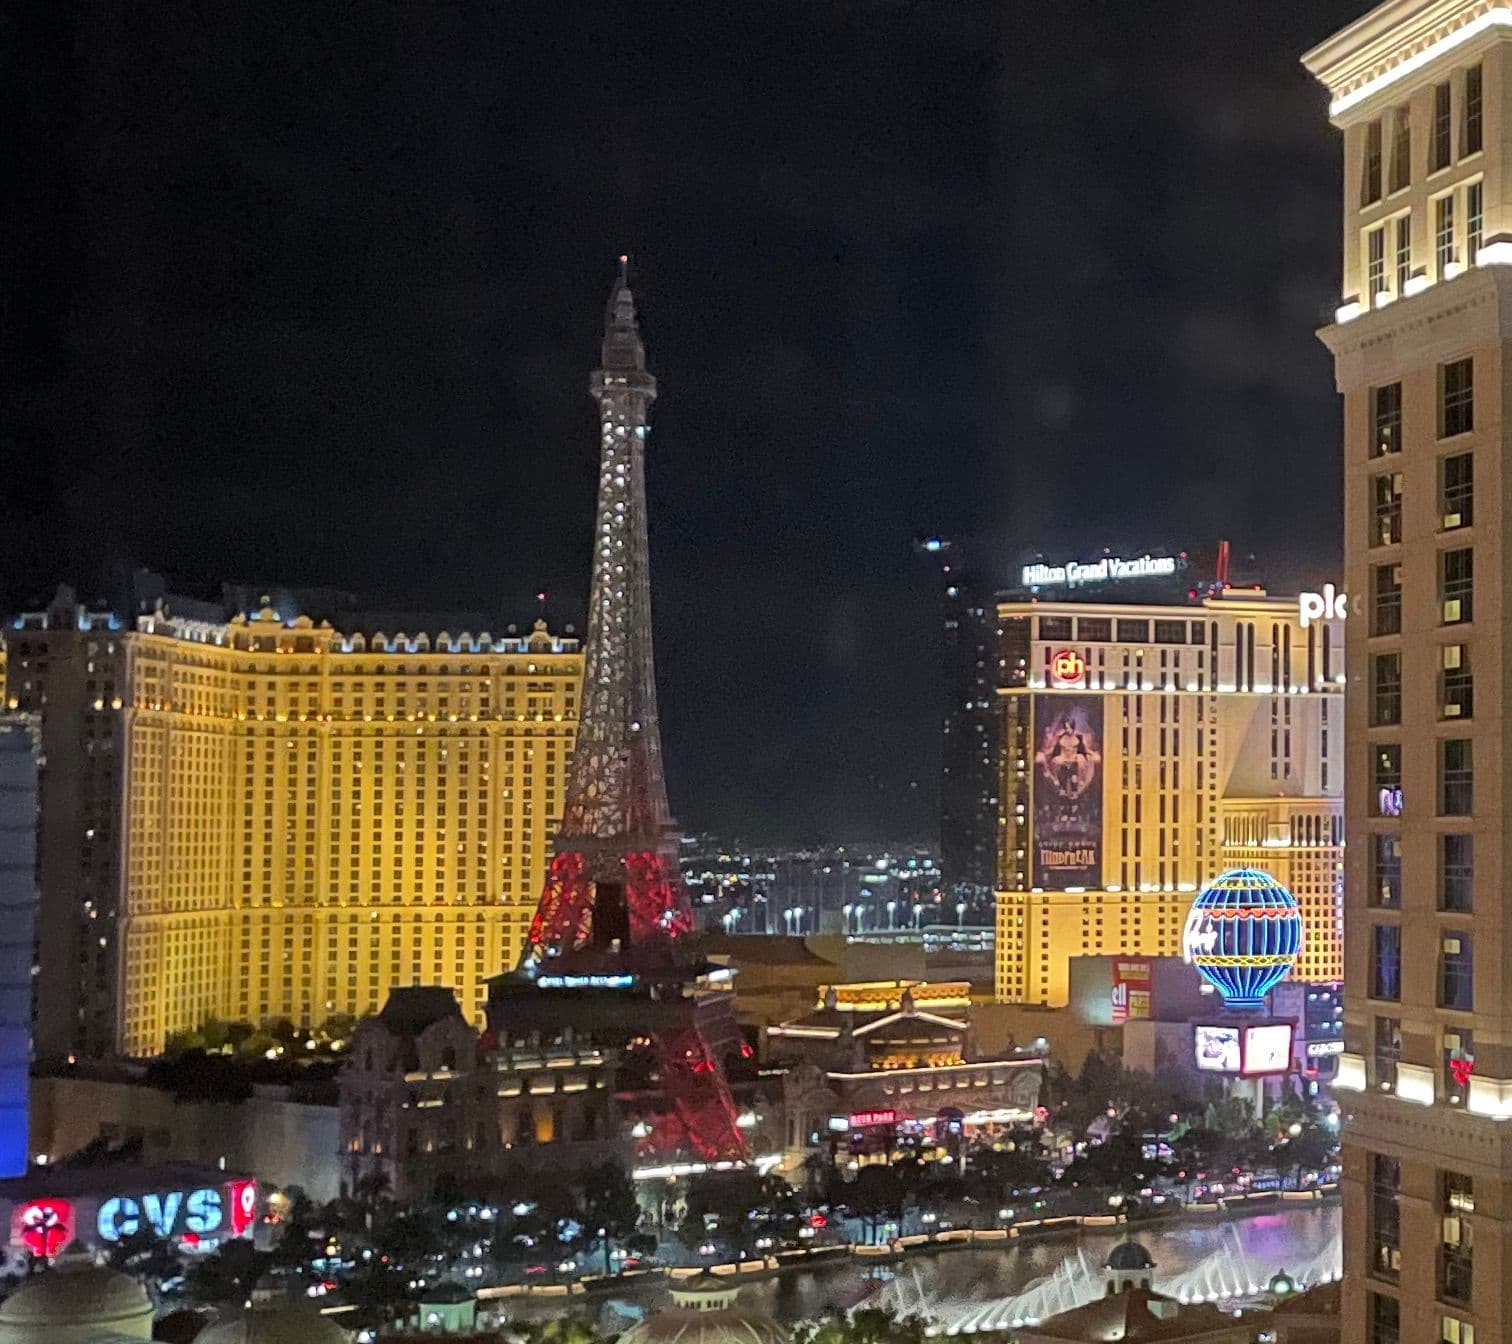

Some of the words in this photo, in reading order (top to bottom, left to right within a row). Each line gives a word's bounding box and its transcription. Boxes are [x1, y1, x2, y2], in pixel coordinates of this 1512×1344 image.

[1022, 564, 1066, 586] Hilton
[1066, 558, 1108, 582] Grand
[1108, 554, 1175, 578] Vacations
[1057, 652, 1084, 677] ph
[97, 1189, 223, 1241] CVS
